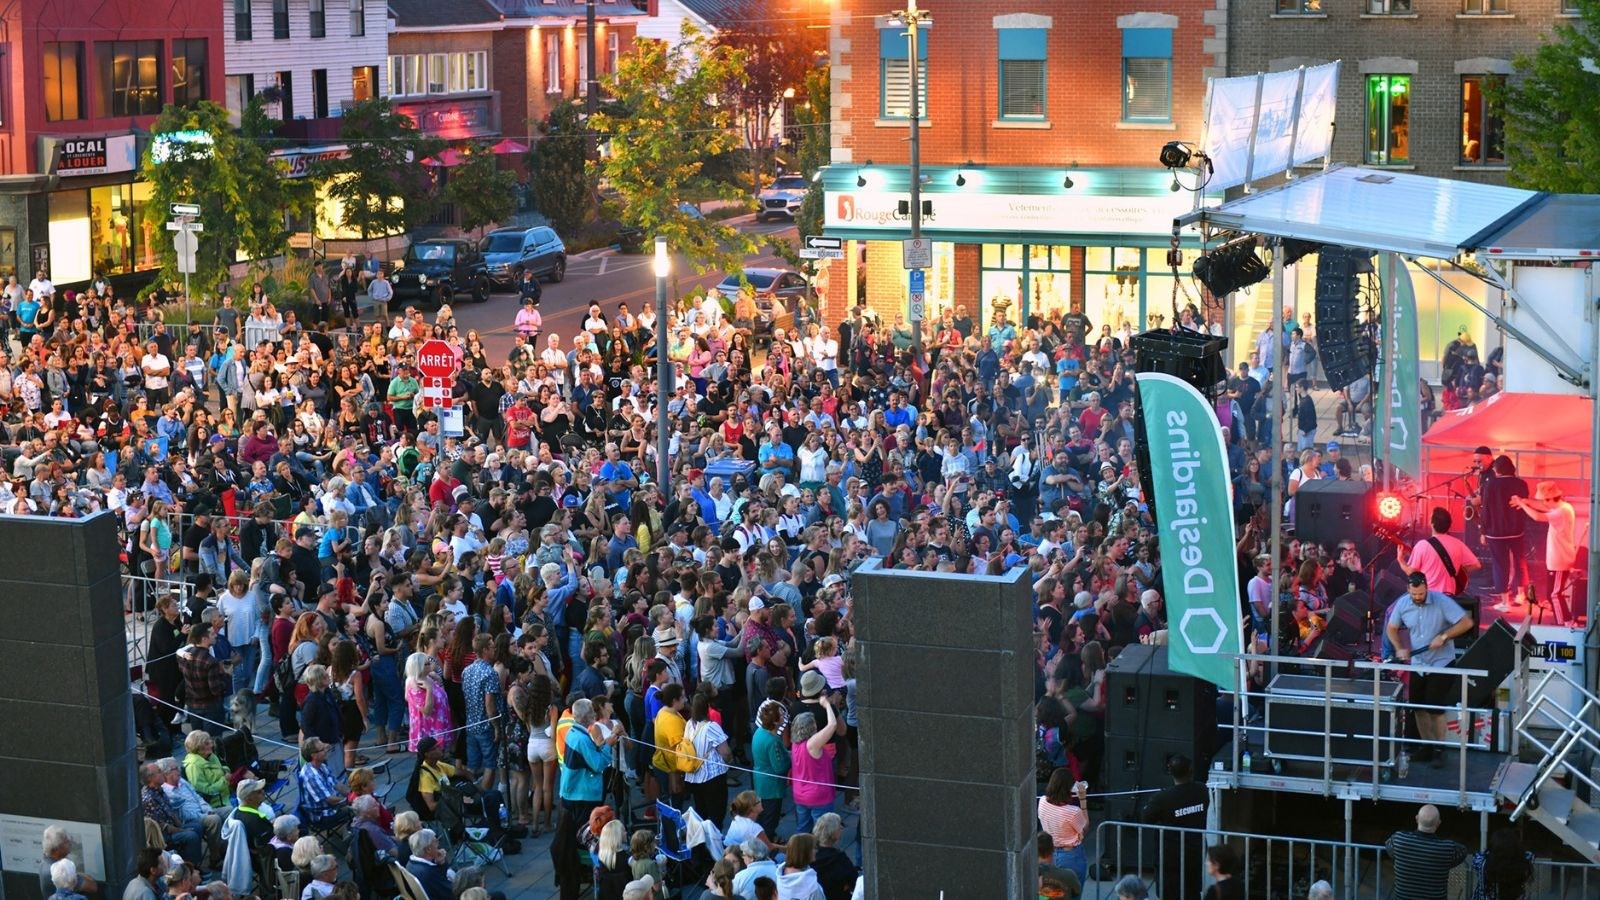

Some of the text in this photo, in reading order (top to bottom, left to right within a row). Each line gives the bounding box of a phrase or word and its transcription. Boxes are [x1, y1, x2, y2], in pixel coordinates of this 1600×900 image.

[67, 156, 104, 168] LOUER
[420, 354, 453, 367] ARRÊT
[1560, 647, 1574, 657] 100
